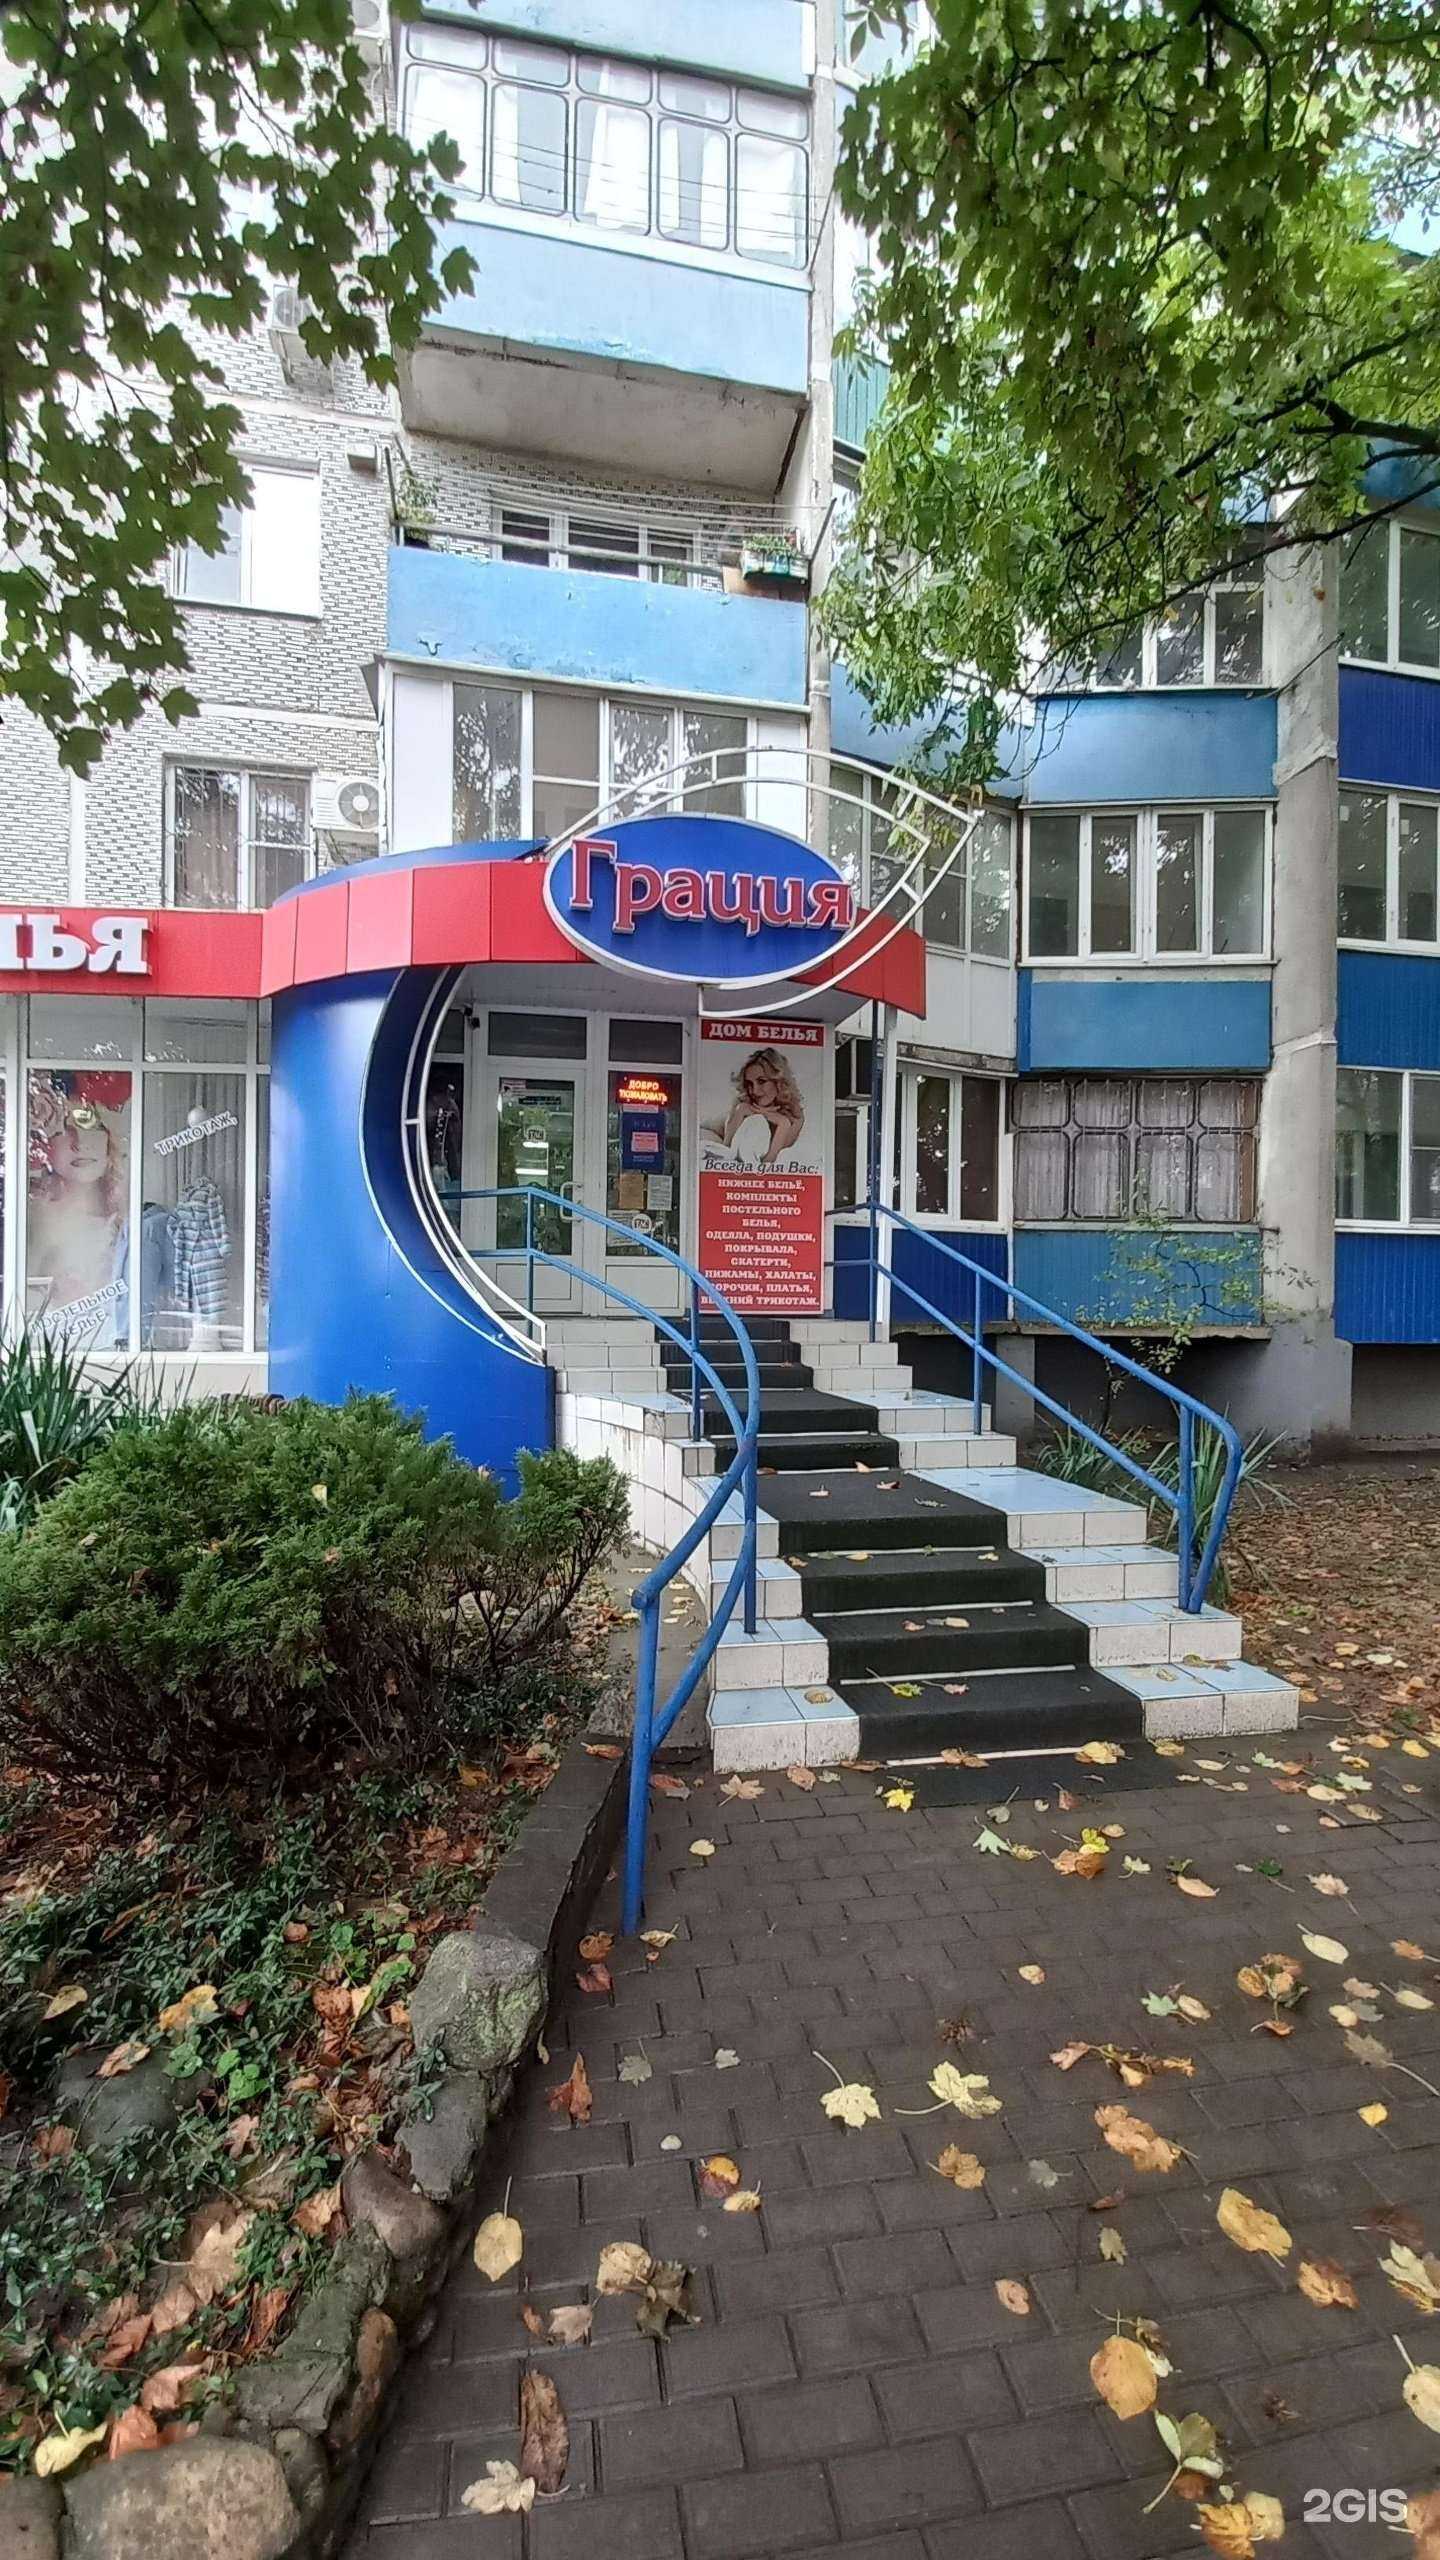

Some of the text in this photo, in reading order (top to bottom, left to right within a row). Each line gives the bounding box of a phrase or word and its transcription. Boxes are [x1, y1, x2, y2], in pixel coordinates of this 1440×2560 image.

[570, 836, 853, 937] Грация
[709, 1023, 818, 1042] ДОМ БЕЛЬЯ
[628, 1080, 659, 1090] ДОБРО
[154, 1111, 238, 1156] ТРИКОТАЖ,
[704, 1158, 819, 1174] Всегда для Вас:
[718, 1179, 806, 1191] НИЖНЕЕ БЕЛЬЁ,
[726, 1192, 798, 1202] КОМПЛЕКТЫ
[722, 1205, 801, 1215] ПОСТЕЛЬНОГО
[742, 1218, 781, 1228] БЕЛЬЯ,
[706, 1230, 816, 1242] ОДЕЯЛА, ПОДУШКИ,
[724, 1244, 798, 1256] ПОКРЫВАЛА,
[730, 1257, 792, 1268] СКАТЕРТИ,
[705, 1270, 816, 1281] ПИЖАМЫ, ХАЛАТЫ,
[711, 1283, 813, 1295] ОРОЧКИ, ПЛАТЬЯ,
[701, 1295, 820, 1306] ВЕХНИЙ ТРИКОТАЖ.
